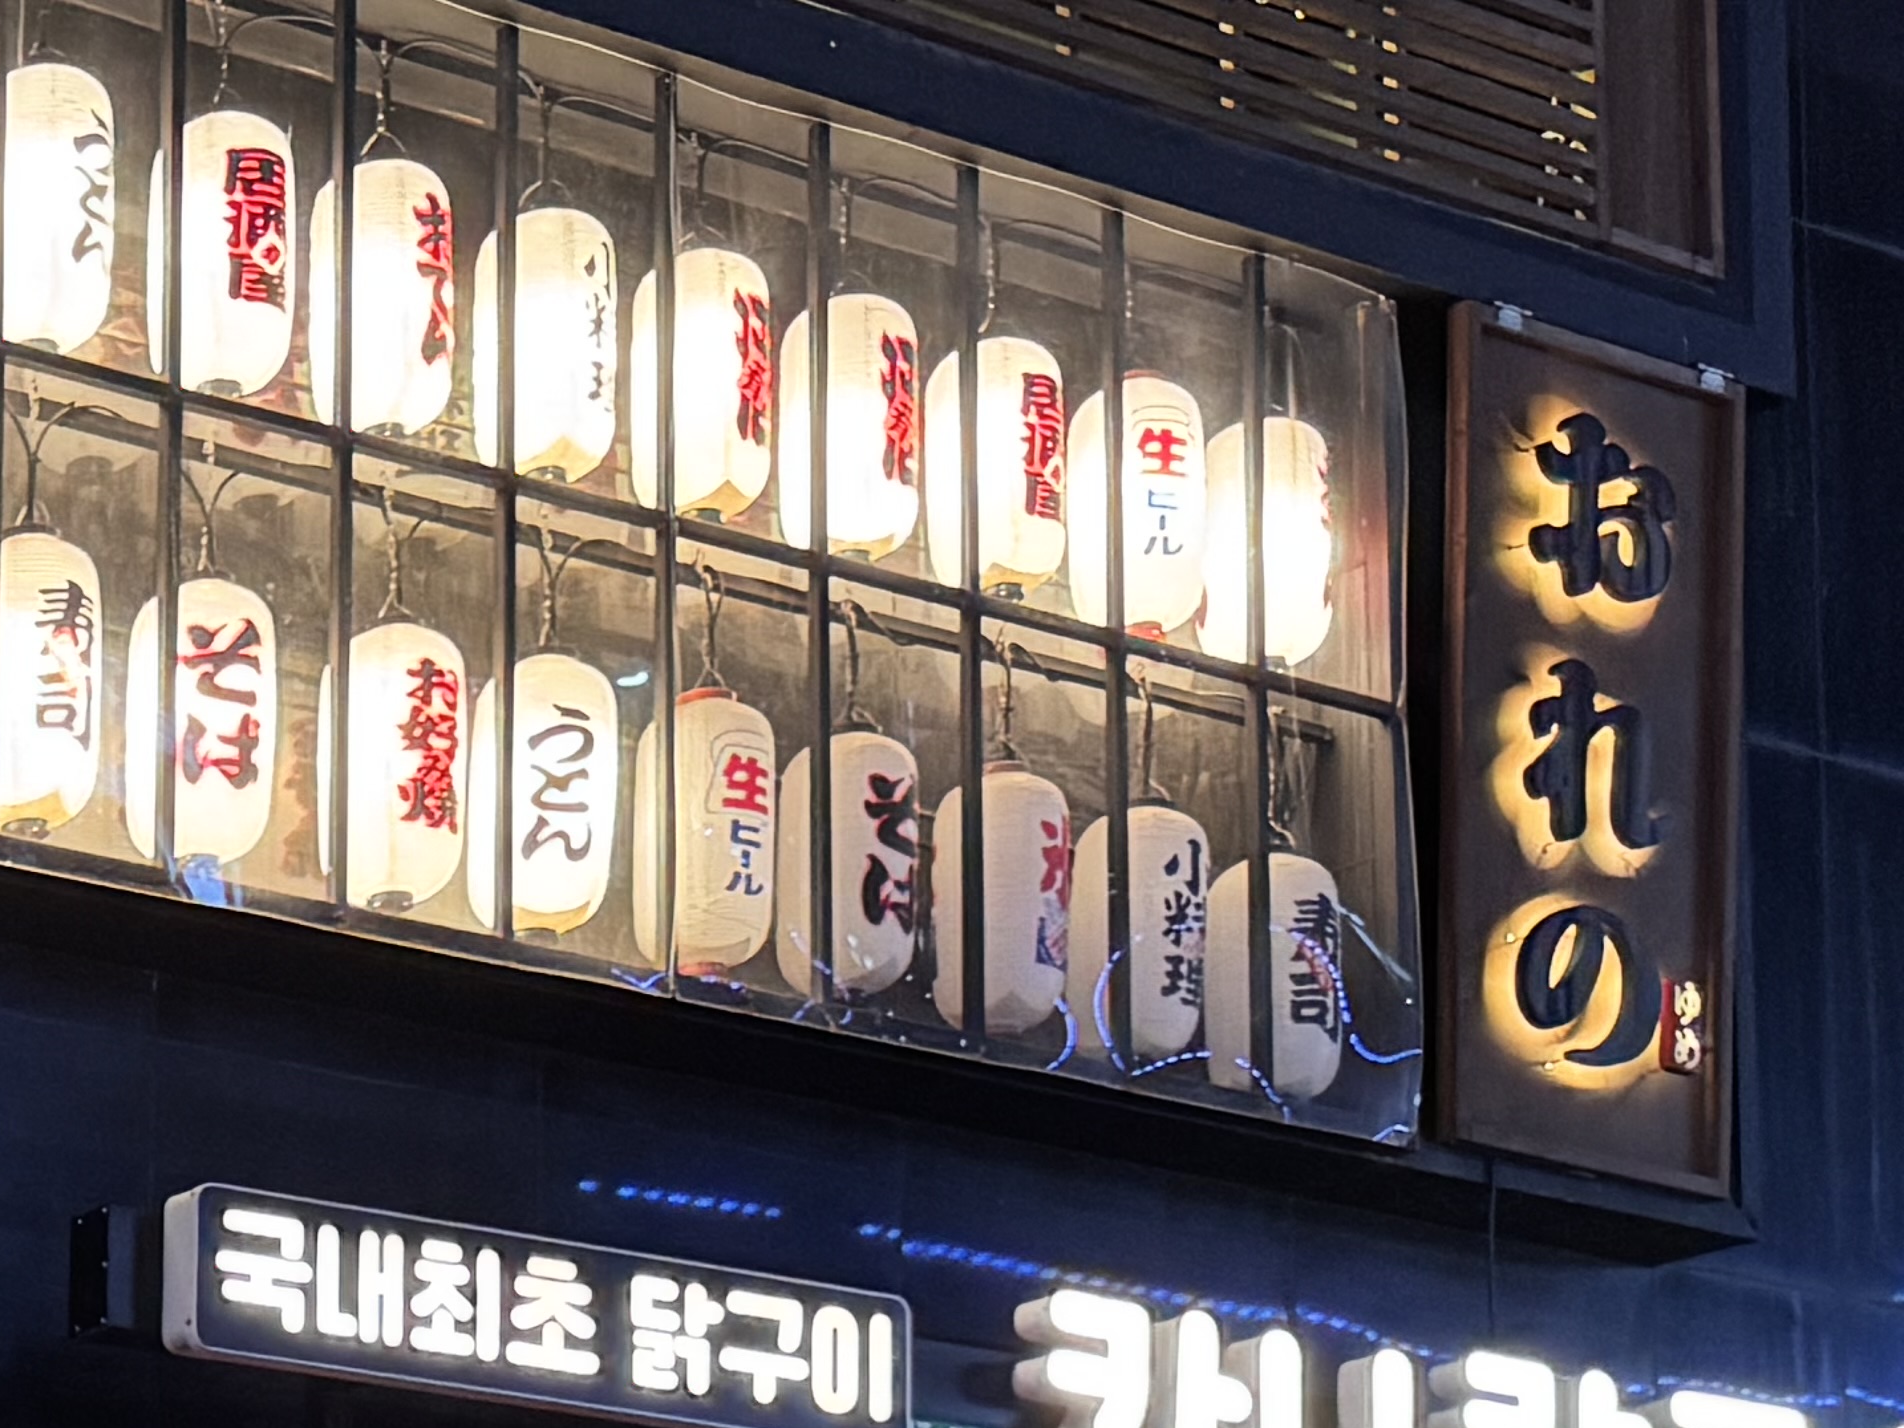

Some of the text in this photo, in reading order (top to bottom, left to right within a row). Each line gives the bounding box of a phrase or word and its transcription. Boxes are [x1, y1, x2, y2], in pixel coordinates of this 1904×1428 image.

[1514, 411, 1676, 1067] おれの
[215, 1209, 893, 1422] 국내최초 닭구이
